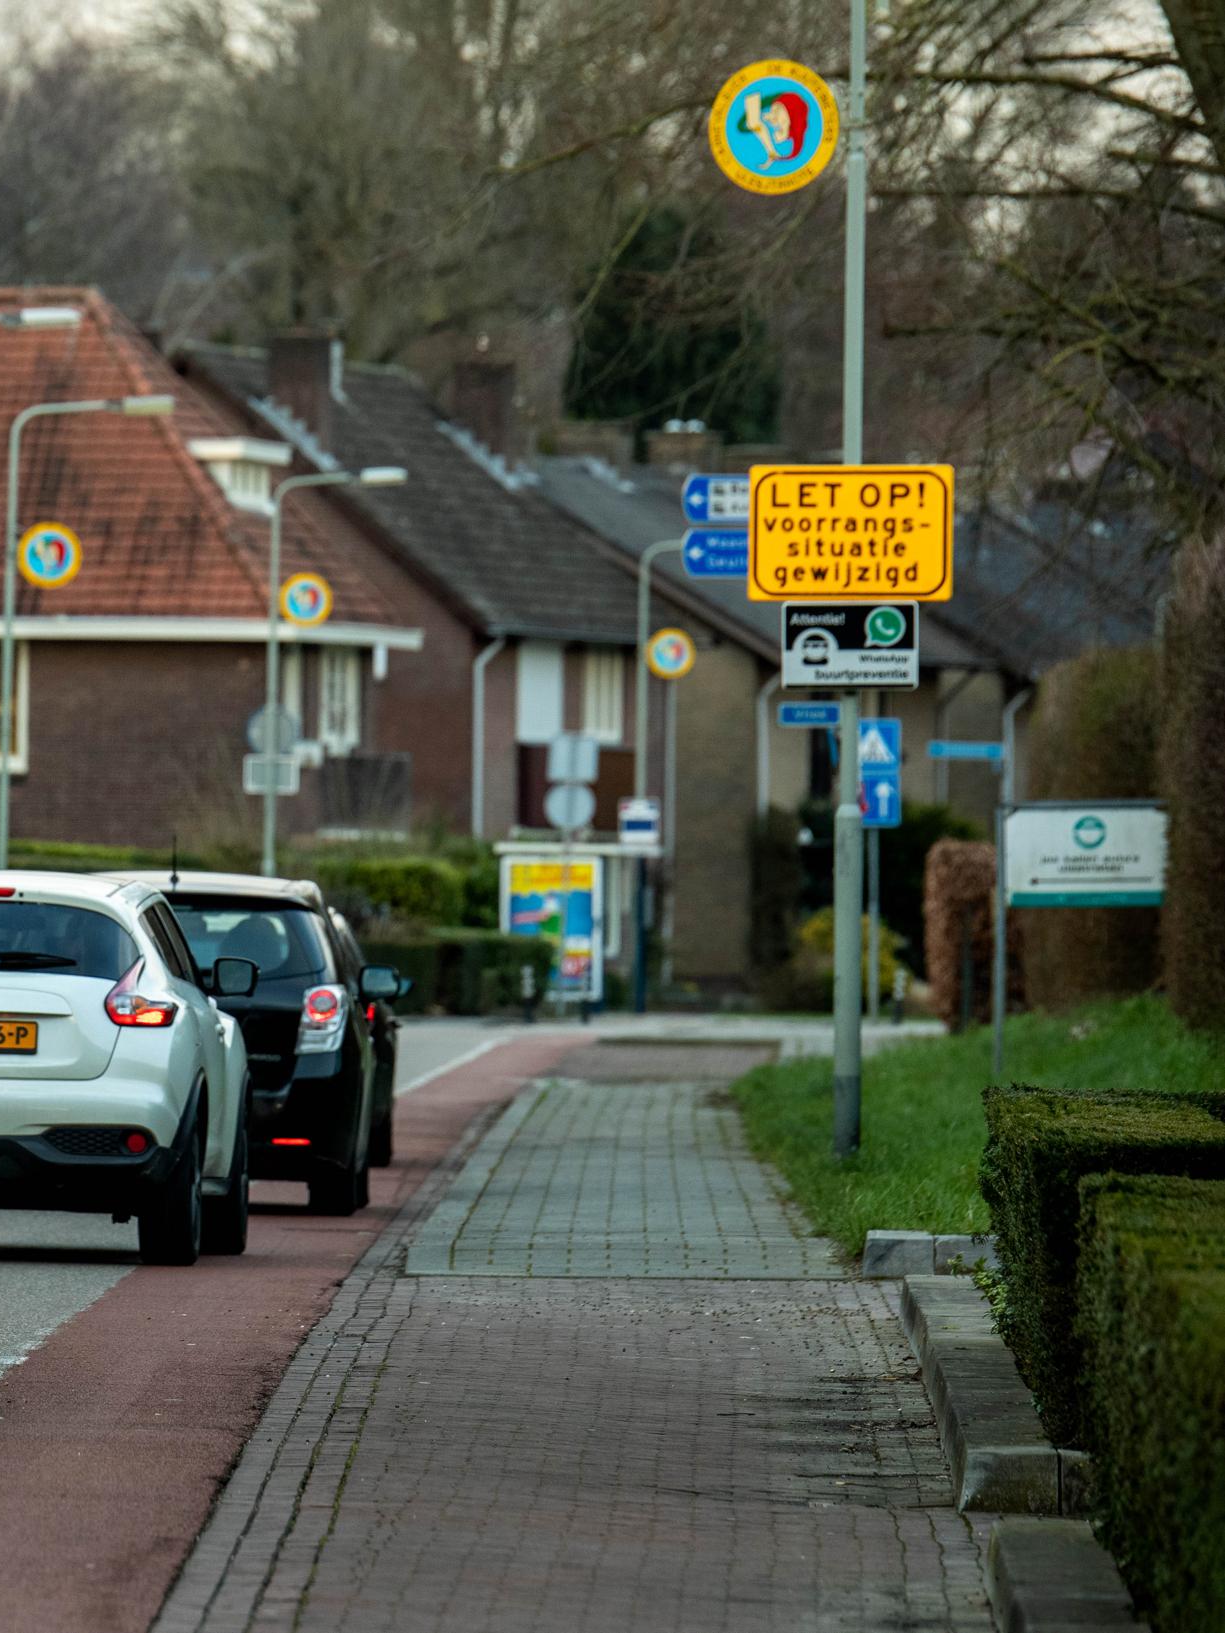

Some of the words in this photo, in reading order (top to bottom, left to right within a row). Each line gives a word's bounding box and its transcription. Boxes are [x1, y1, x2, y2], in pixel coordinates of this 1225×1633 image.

[772, 482, 842, 508] LET
[859, 482, 925, 508] OP!
[764, 516, 931, 538] voorrangs-
[787, 537, 907, 557] situatie
[774, 561, 919, 588] gewijzigd
[789, 612, 846, 626] Attentie!
